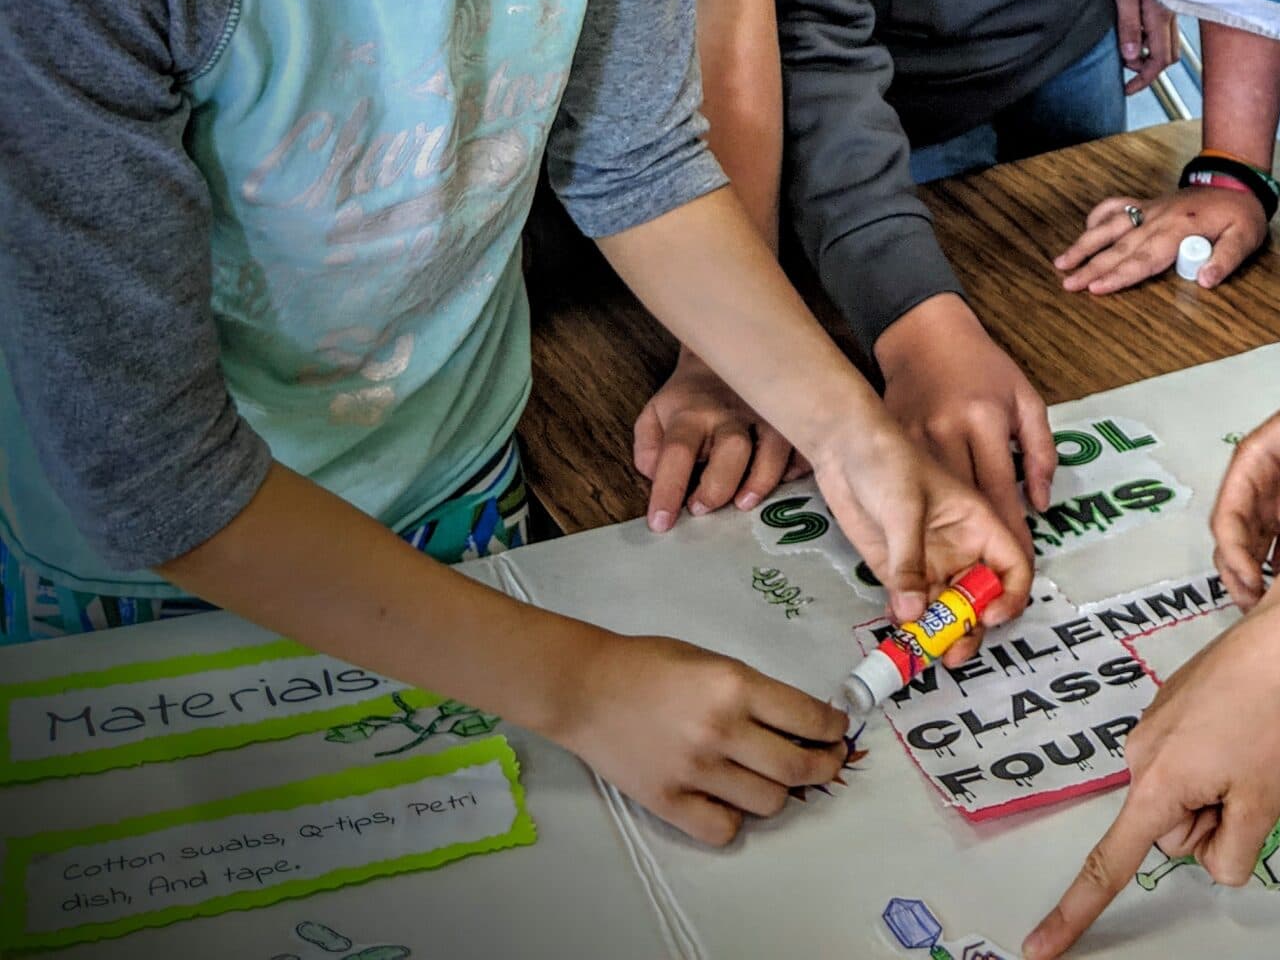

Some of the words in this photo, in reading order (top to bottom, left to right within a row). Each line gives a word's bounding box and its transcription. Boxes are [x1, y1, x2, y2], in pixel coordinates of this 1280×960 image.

[889, 567, 1275, 708] WEILENMA
[907, 655, 1148, 739] CLASS
[61, 889, 133, 912] dish,
[147, 871, 209, 897] And
[223, 858, 301, 884] tape.
[62, 851, 165, 882] Cotton
[180, 832, 286, 860] swabs,
[299, 810, 396, 839] Q-tips,
